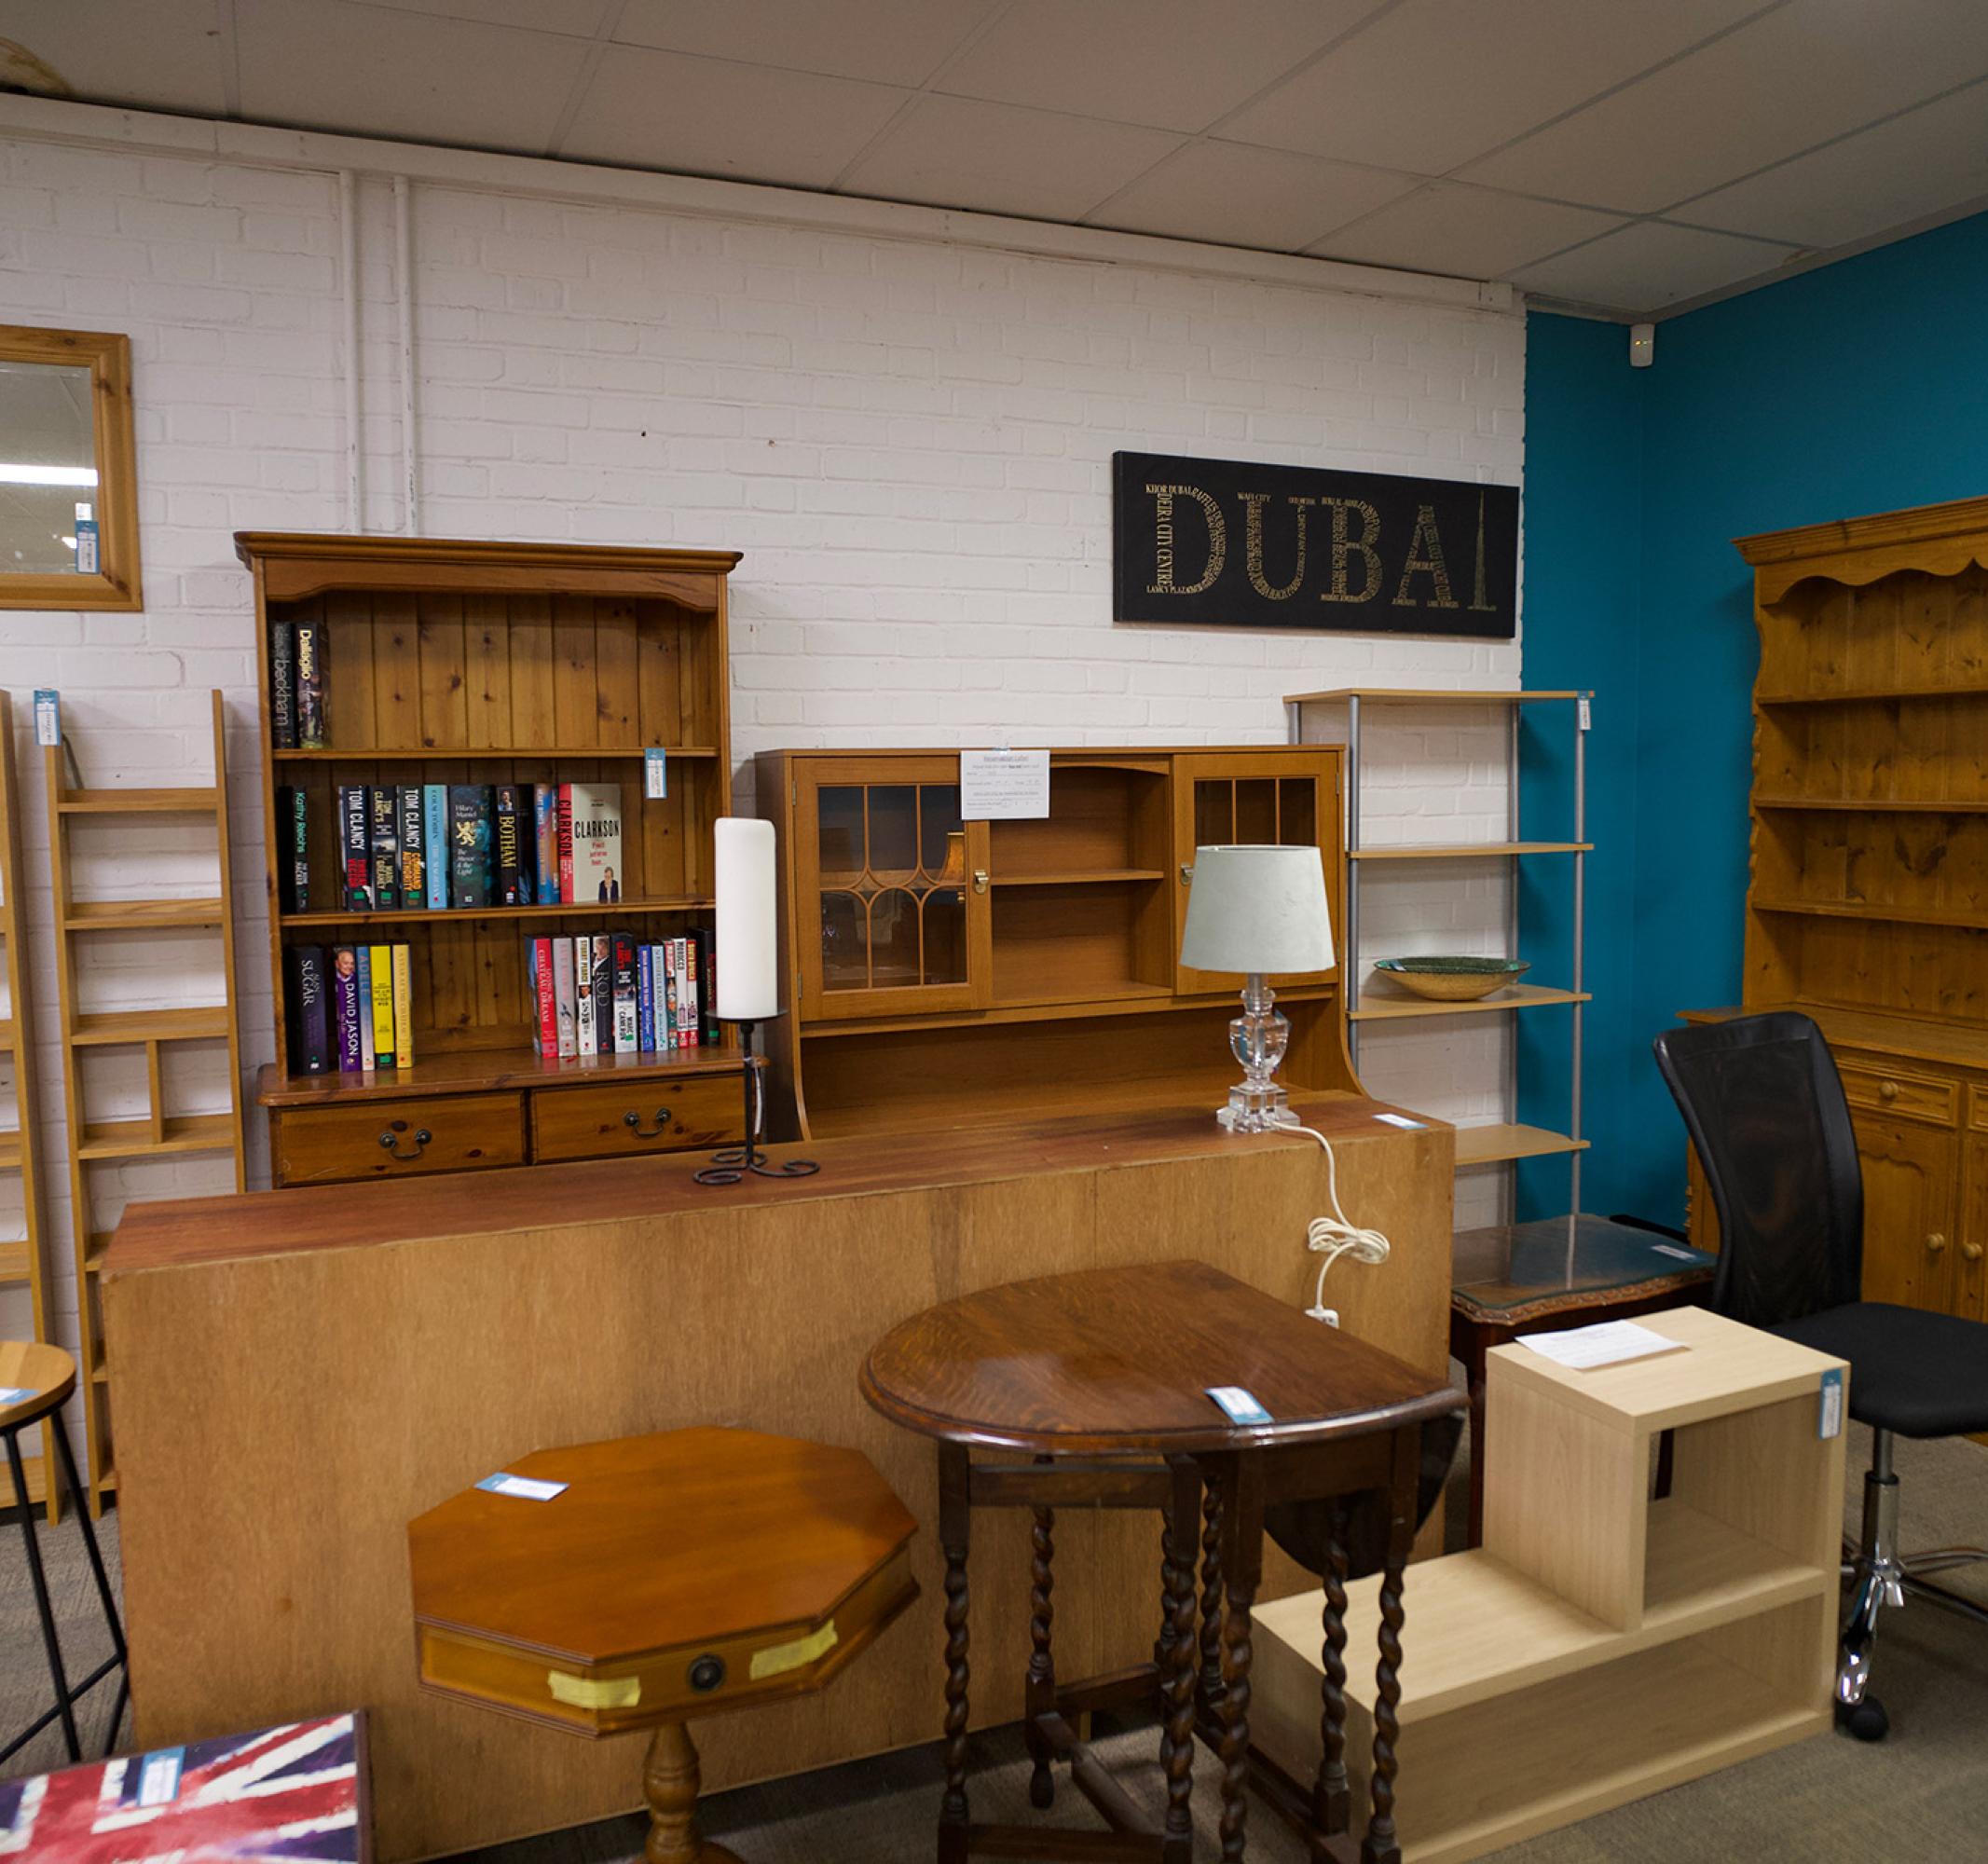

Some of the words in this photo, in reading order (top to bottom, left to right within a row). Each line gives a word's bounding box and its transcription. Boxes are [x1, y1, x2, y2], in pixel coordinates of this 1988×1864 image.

[1157, 492, 1172, 523] DEIRA
[1145, 483, 1497, 612] DUBAI
[1157, 524, 1172, 546] CITY
[1157, 549, 1172, 586] CENTRE
[299, 629, 313, 680] Dallaglio
[274, 659, 291, 726] beckham
[294, 792, 306, 821] Kathy
[349, 789, 363, 811] TOM
[404, 788, 419, 809] TOM
[350, 813, 365, 850] CLANCY
[405, 812, 420, 849] CLANCY
[499, 816, 516, 868] BOTHAM
[559, 799, 573, 857] CLARKSON
[574, 820, 620, 839] CLARKSON
[301, 960, 315, 1007] SUGAR
[359, 955, 371, 995] ADELE
[596, 971, 610, 1007] ROD
[345, 983, 356, 1017] DAVID
[541, 992, 550, 1022] DREAM
[346, 1020, 359, 1056] JASON
